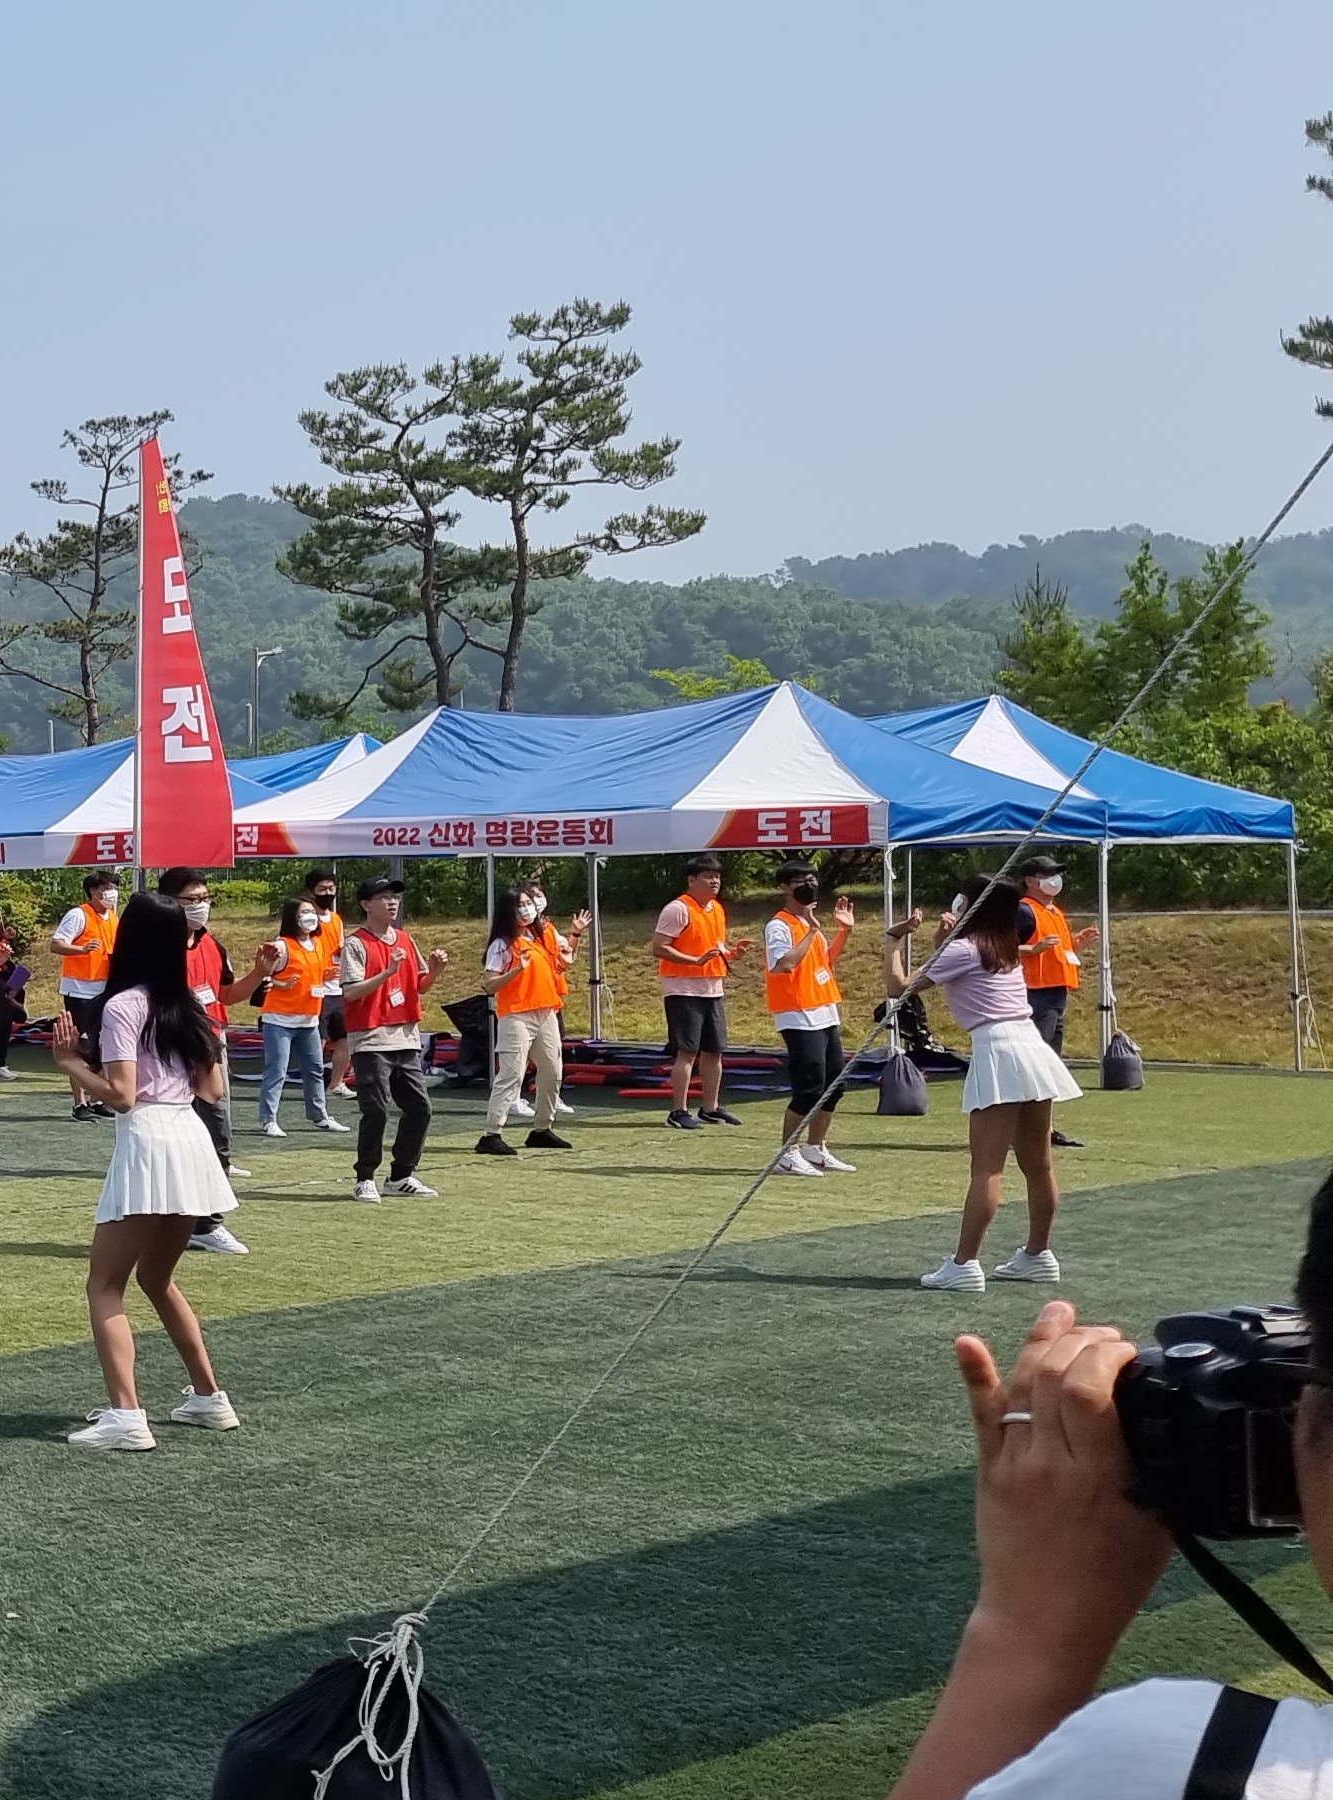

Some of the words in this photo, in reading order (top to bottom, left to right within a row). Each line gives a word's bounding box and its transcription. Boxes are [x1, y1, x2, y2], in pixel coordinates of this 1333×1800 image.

[161, 555, 213, 764] 도전
[235, 825, 260, 853] 전
[372, 827, 421, 846] 2022
[428, 820, 476, 848] 신화
[485, 817, 614, 847] 명랑운동회
[757, 809, 832, 843] 도전
